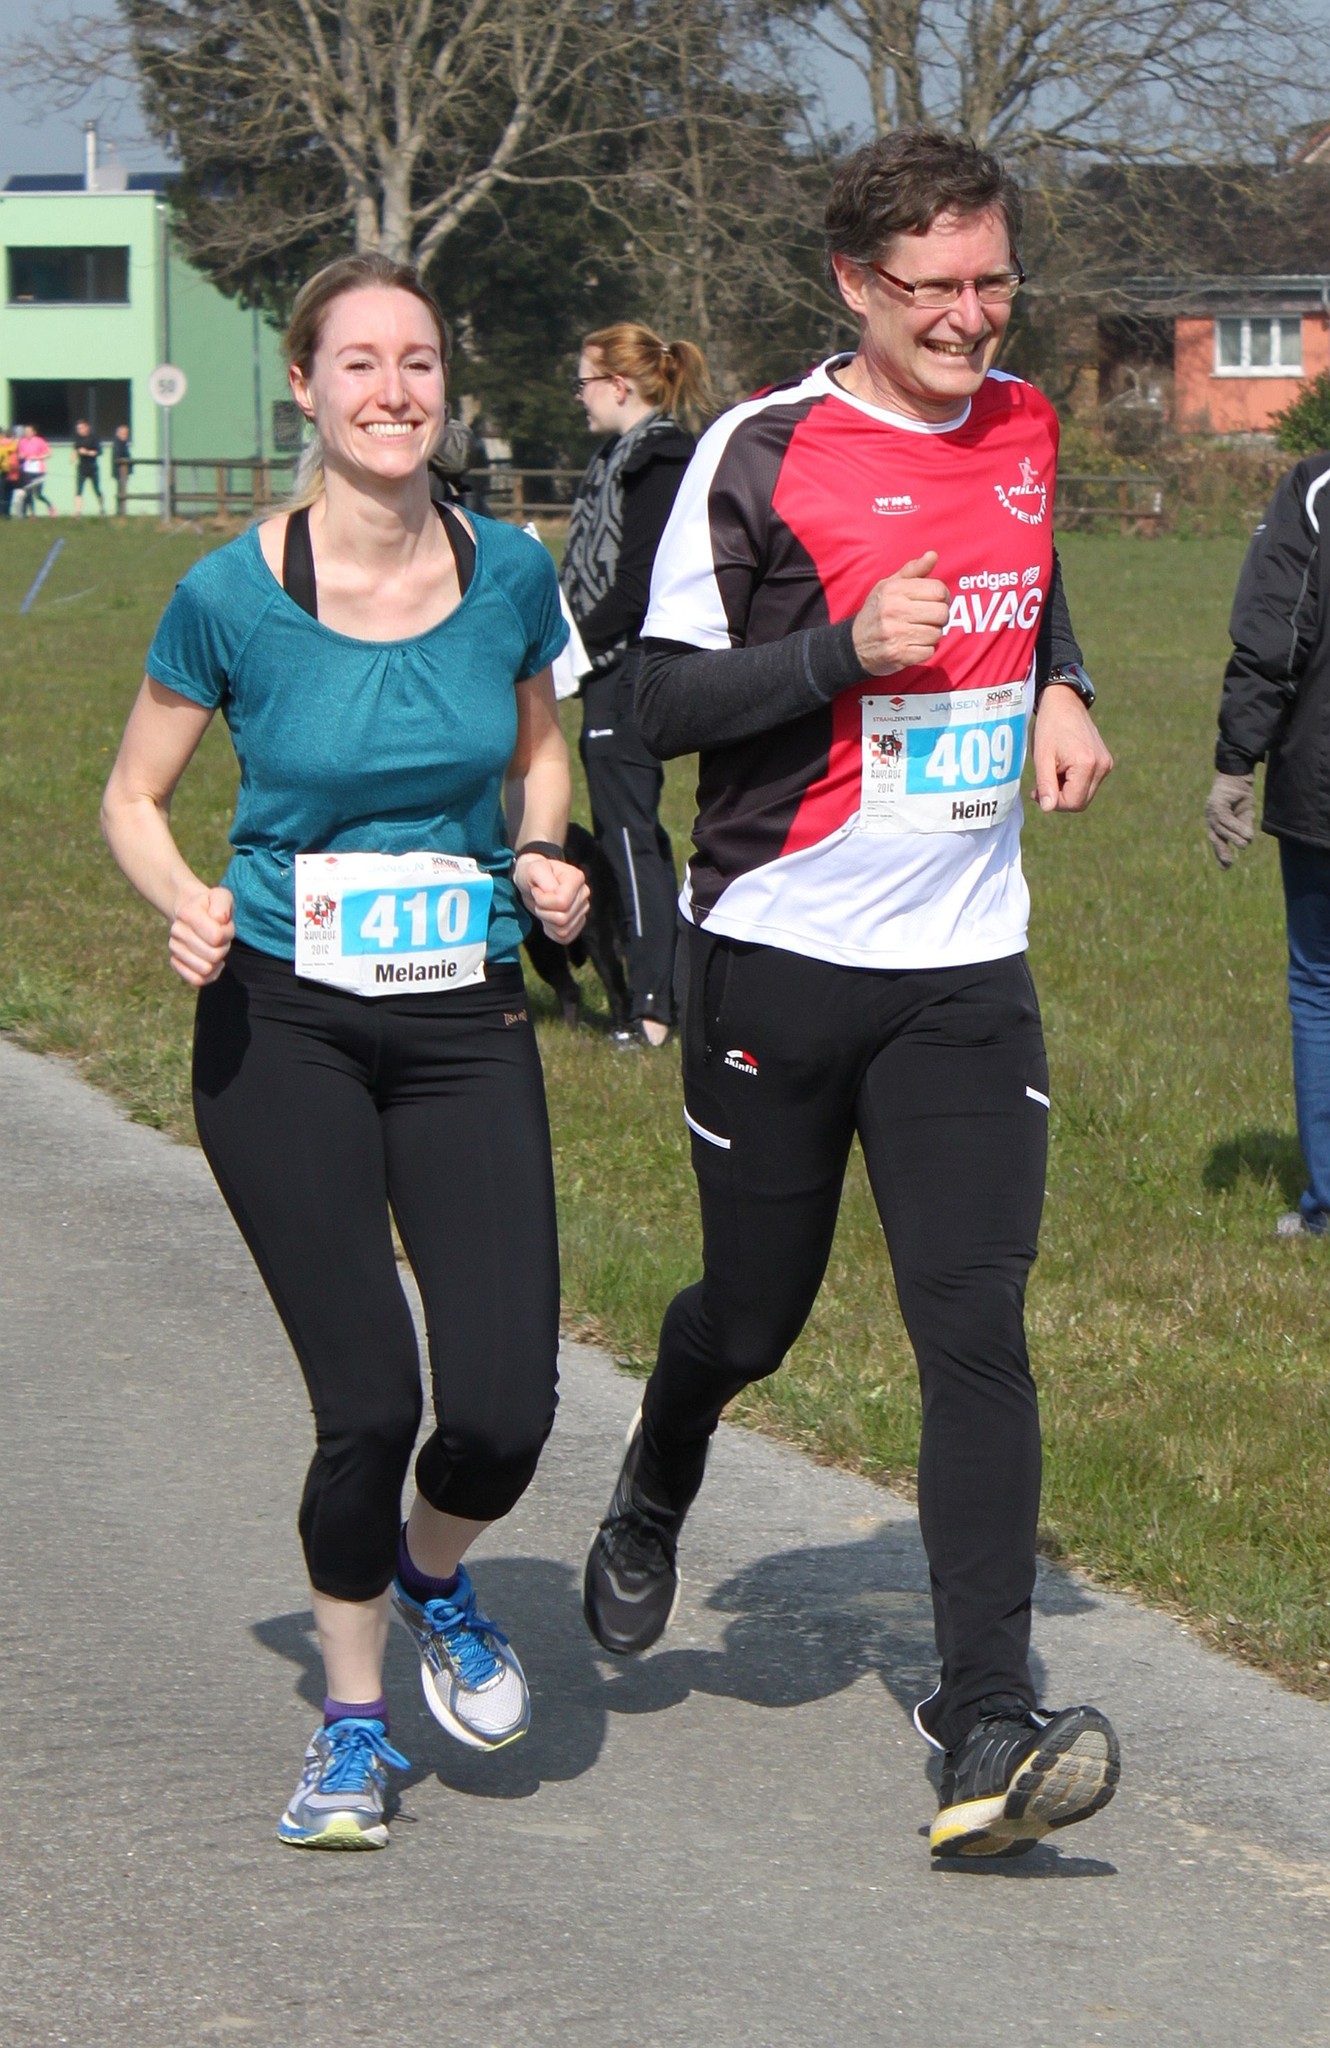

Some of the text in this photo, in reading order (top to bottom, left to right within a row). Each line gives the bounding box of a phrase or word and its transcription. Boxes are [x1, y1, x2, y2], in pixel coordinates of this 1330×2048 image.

[959, 571, 1019, 590] erdgas
[942, 588, 1043, 635] AVAG
[930, 700, 979, 713] JANSEN
[925, 725, 1014, 787] 409
[877, 783, 895, 793] 2016
[951, 800, 999, 820] Heinz
[360, 888, 470, 948] 410
[311, 944, 330, 955] 2016
[375, 959, 457, 983] Melanie
[724, 1057, 758, 1076] skinfit
